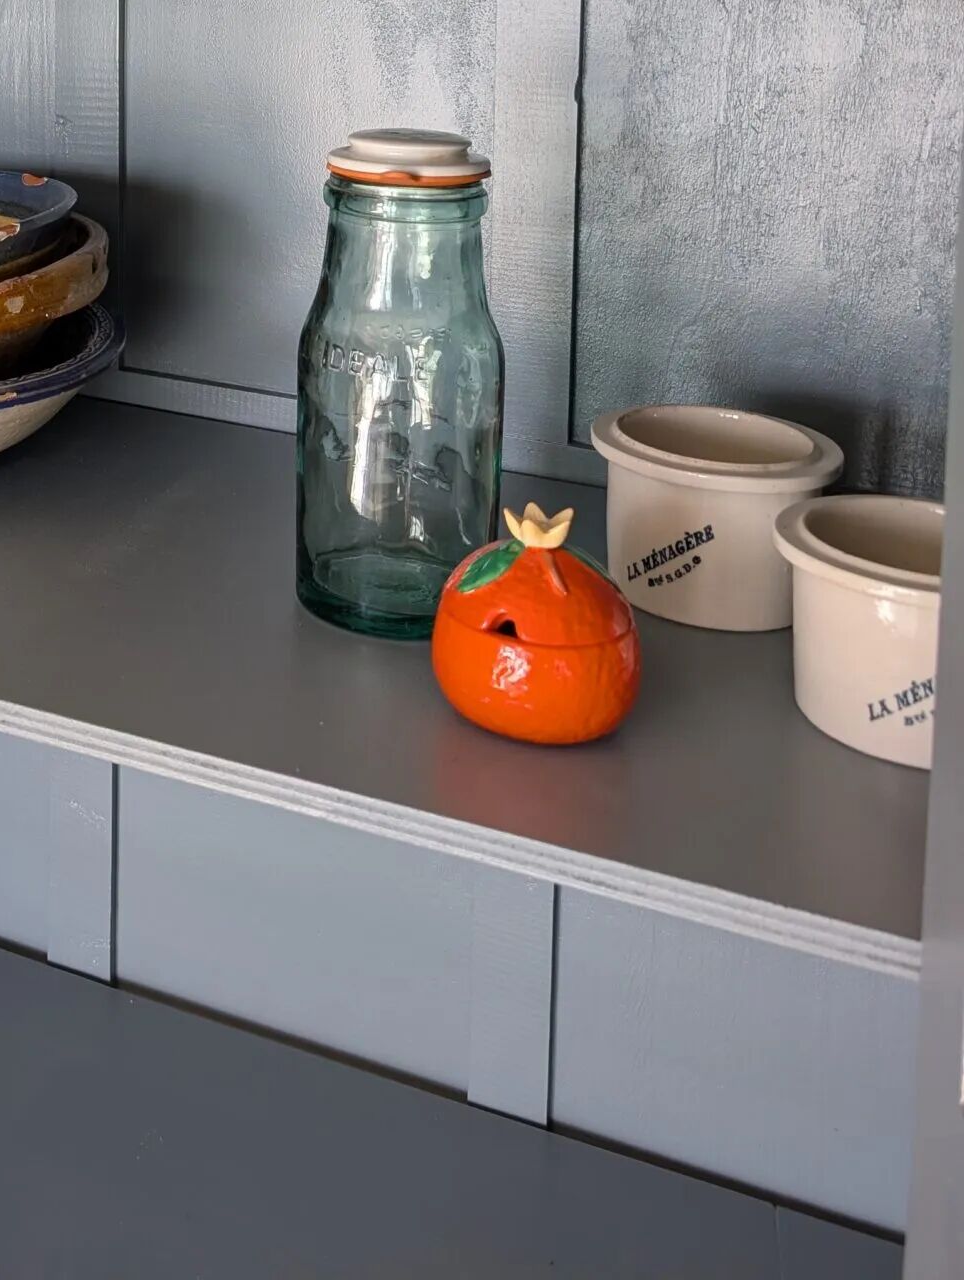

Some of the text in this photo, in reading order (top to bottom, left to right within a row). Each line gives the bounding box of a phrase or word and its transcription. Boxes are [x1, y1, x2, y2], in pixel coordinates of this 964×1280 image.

[627, 524, 715, 582] LA MÉNAGÈRE
[867, 677, 934, 722] LA MÉN
